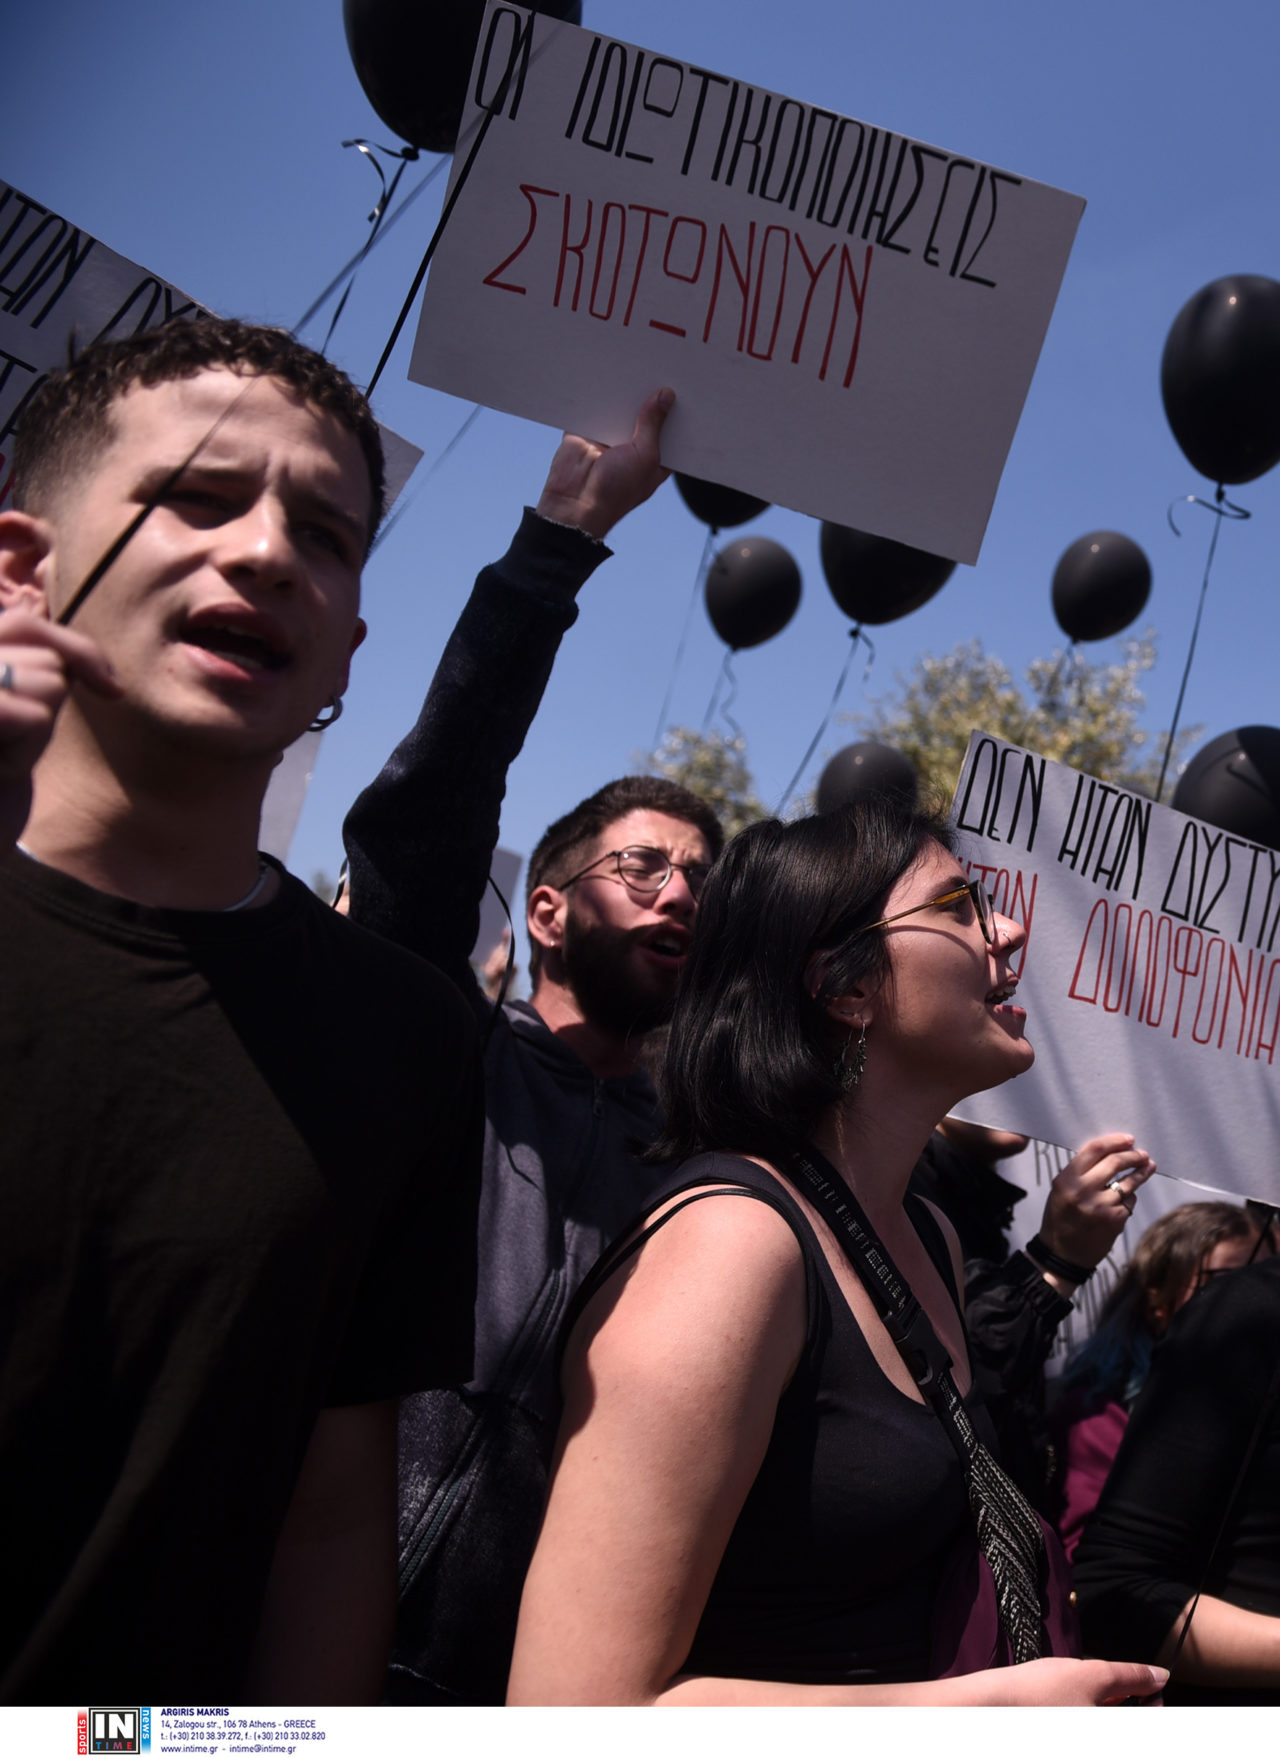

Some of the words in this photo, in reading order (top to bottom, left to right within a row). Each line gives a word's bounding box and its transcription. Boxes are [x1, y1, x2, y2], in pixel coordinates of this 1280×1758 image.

[474, 6, 535, 120] ΟΙ
[564, 36, 1022, 288] ΙΔΙΩΤΙΚΟΠΟΙΗΣΕΙΣ
[482, 184, 873, 389] ΣΚΟΤΩΝΟΥΝ
[957, 738, 1046, 853] ΔΕΝ
[1057, 774, 1152, 901] ΗΤΑΝ
